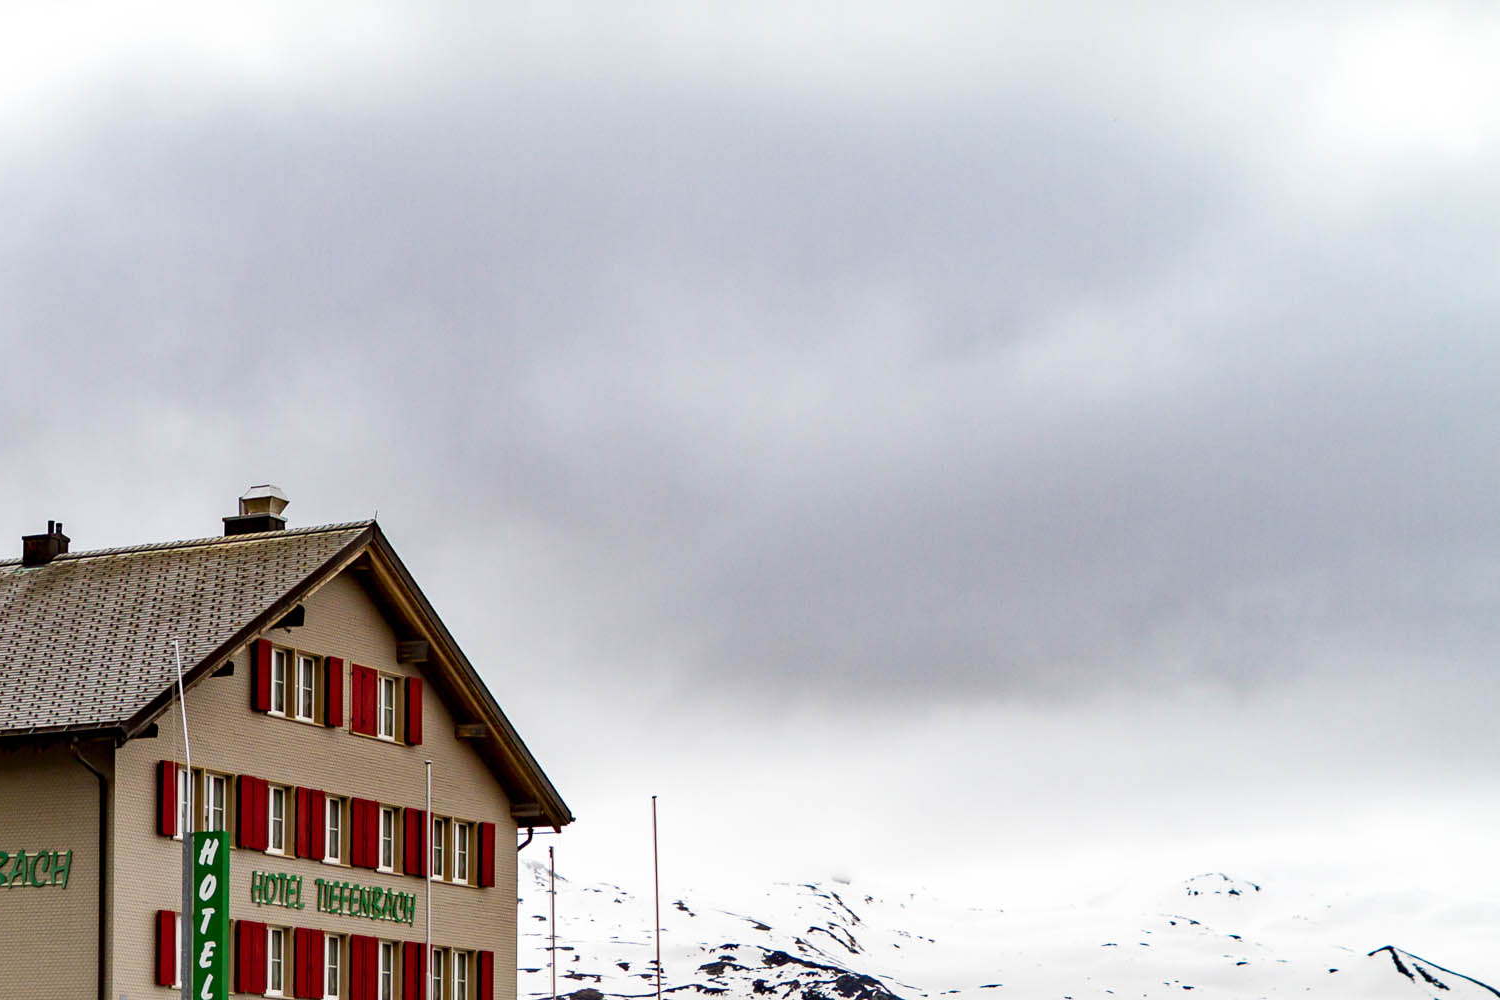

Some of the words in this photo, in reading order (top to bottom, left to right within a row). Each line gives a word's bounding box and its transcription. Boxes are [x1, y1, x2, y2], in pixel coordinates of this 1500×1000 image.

[198, 838, 220, 1000] HOTEL
[251, 870, 305, 910] HOTEL
[315, 878, 417, 928] TIEFENBACH
